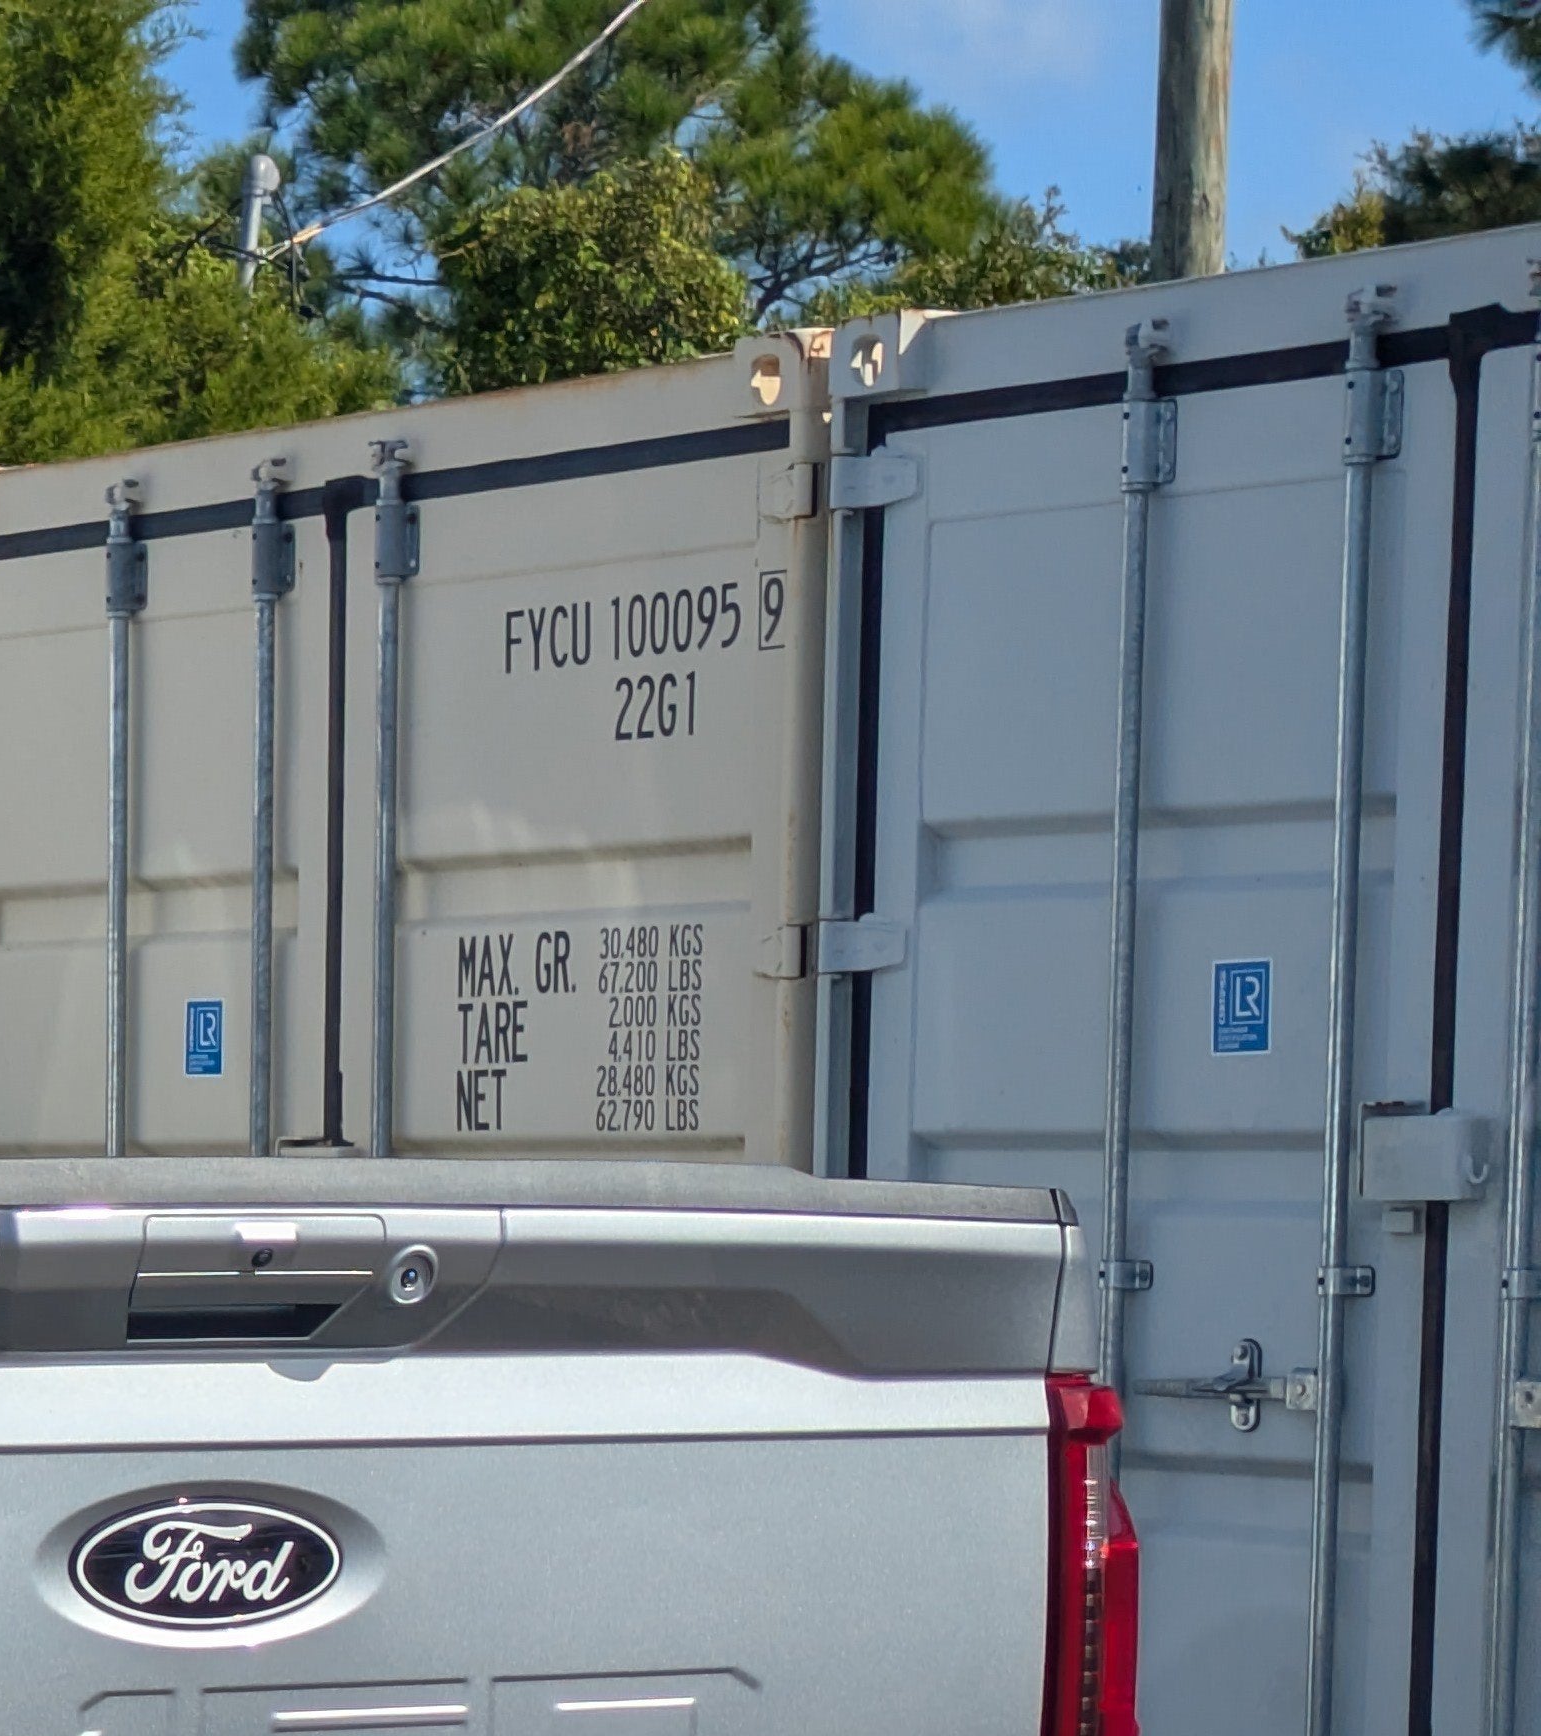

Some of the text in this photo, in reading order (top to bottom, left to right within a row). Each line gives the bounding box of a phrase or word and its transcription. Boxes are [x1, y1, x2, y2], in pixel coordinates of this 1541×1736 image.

[505, 577, 784, 674] FYCU 100095 9
[615, 671, 696, 740] 22G1
[458, 933, 519, 997] MAX.
[535, 931, 576, 993] GR.
[669, 924, 703, 957] KGS
[668, 959, 702, 992] LBS
[458, 1000, 528, 1064] TARE
[667, 994, 701, 1027] KGS
[666, 1030, 700, 1061] LBS
[457, 1069, 507, 1131] NET
[666, 1064, 699, 1096] KGS
[665, 1099, 699, 1130] LBS
[124, 1520, 295, 1604] Ford
